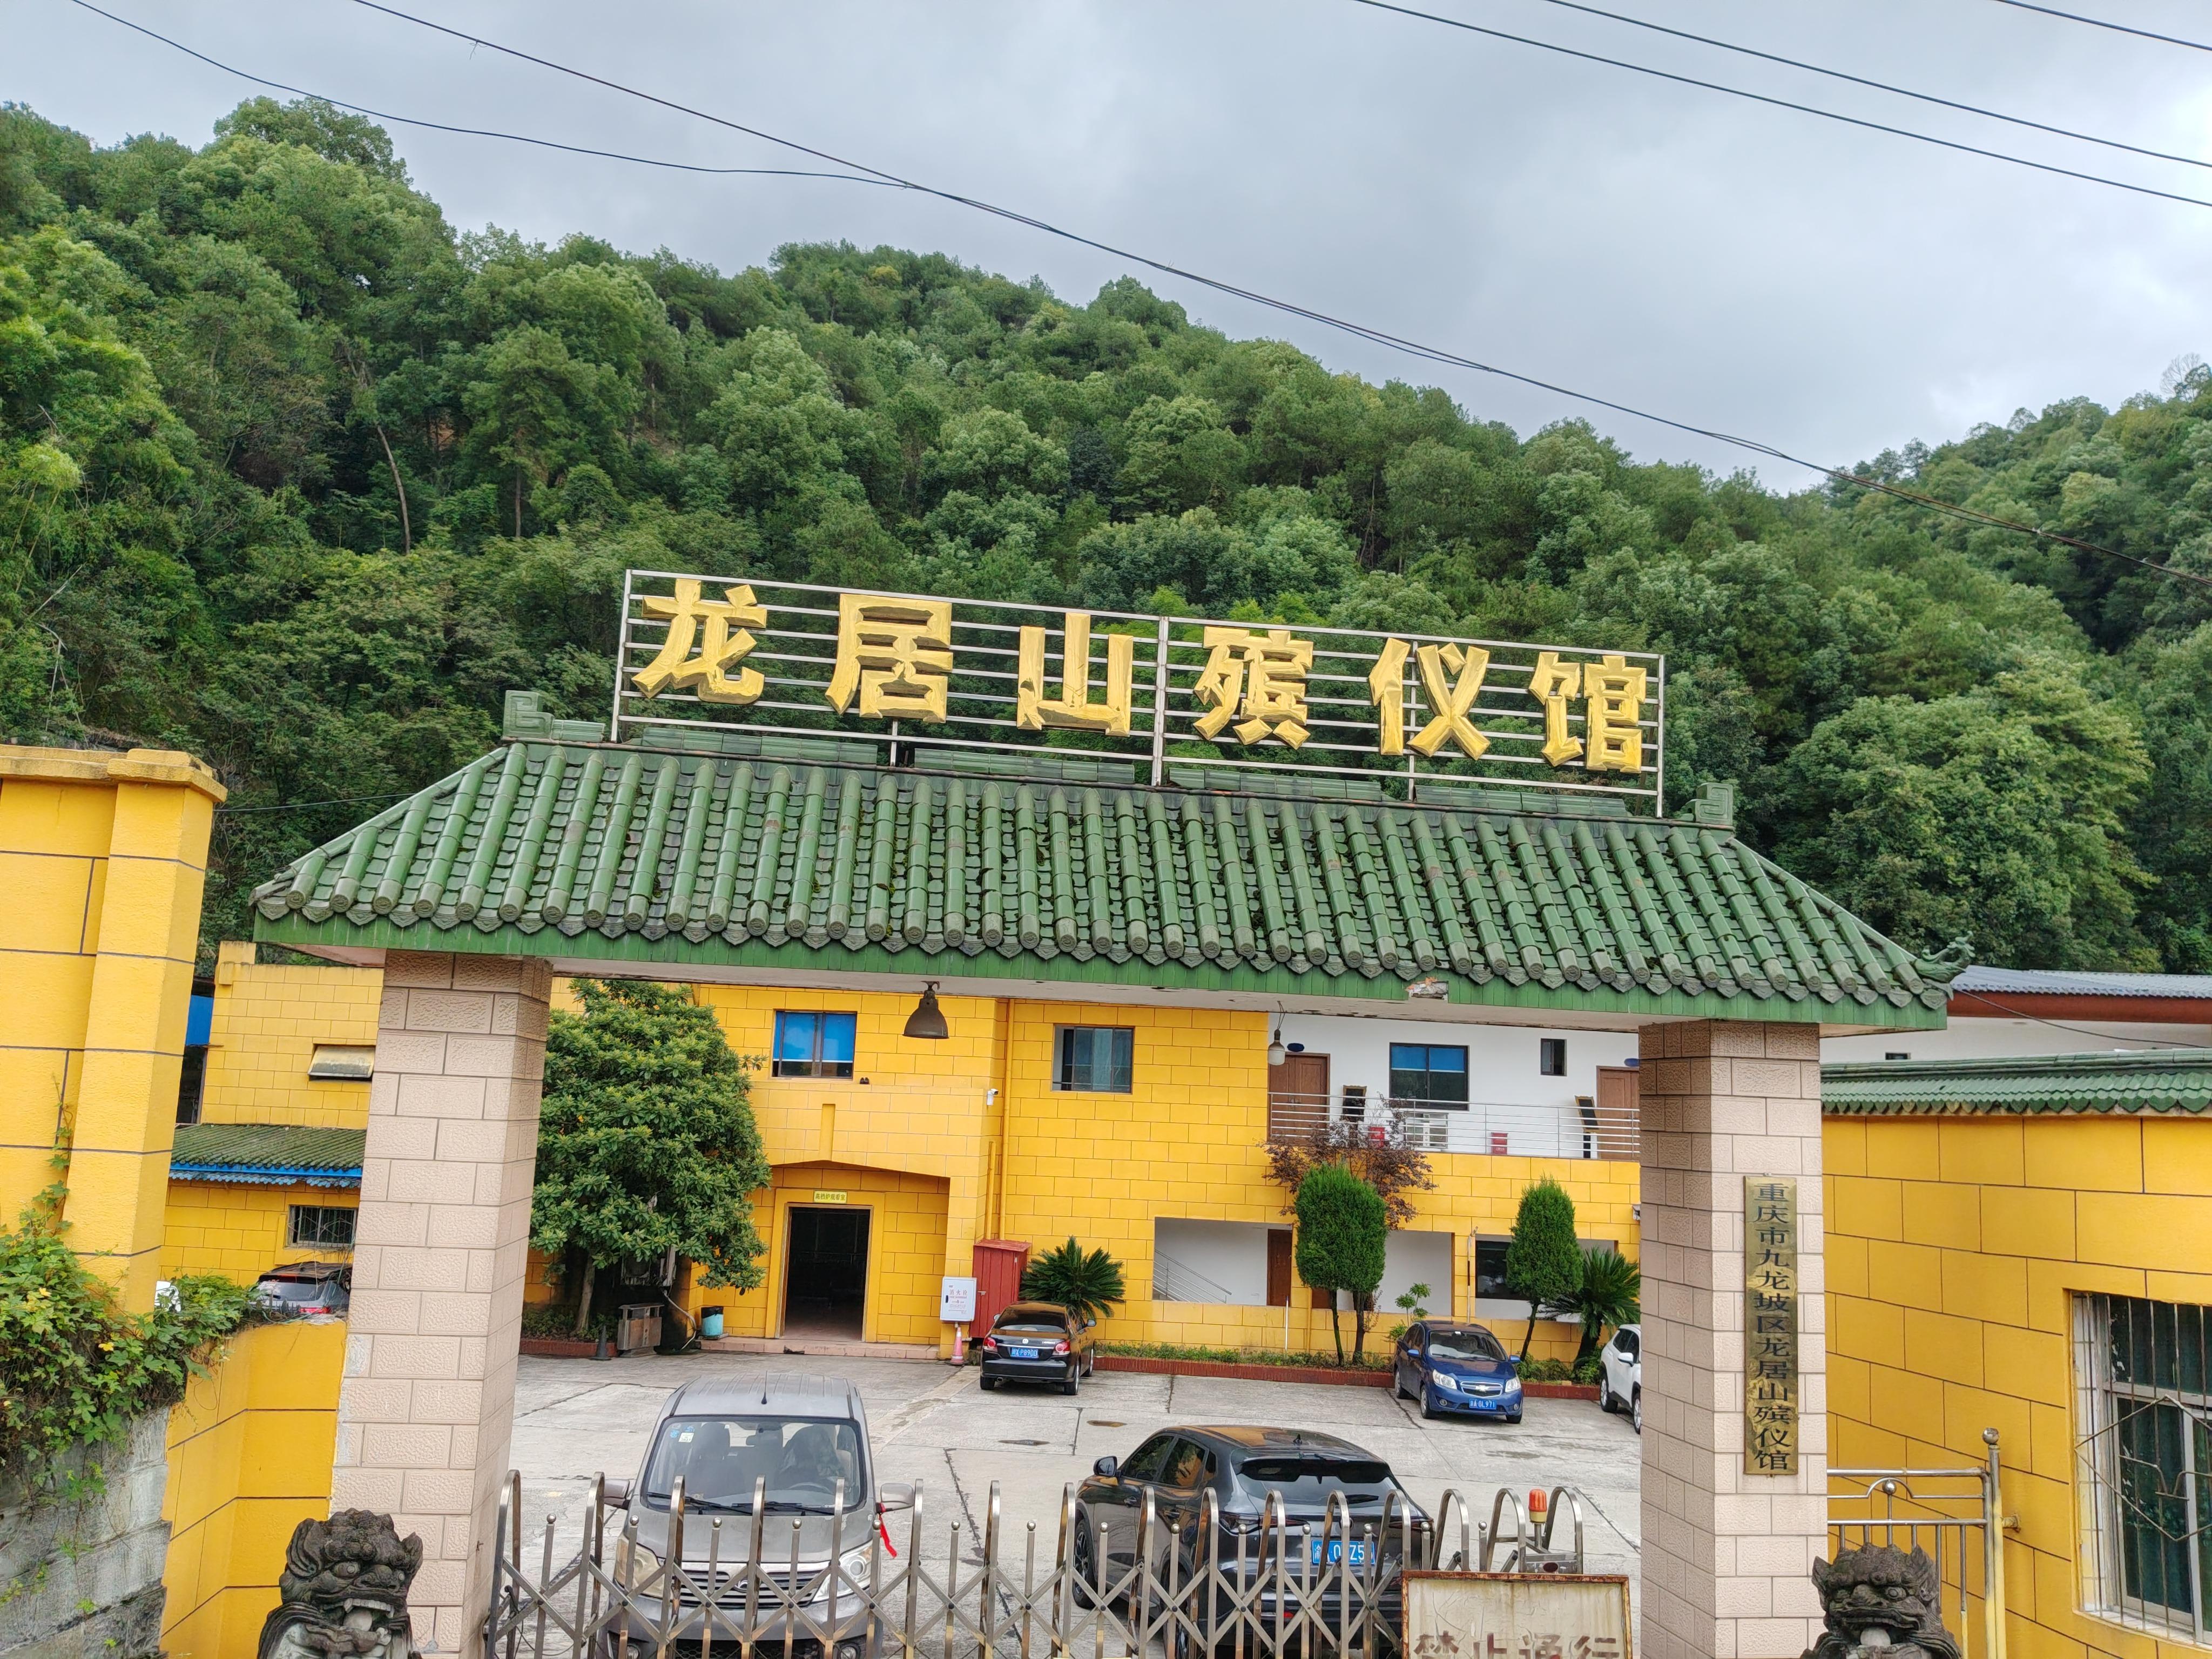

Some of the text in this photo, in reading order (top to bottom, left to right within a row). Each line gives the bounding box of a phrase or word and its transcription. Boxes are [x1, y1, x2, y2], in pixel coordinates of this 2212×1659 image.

[632, 578, 1646, 773] 龙居山殡仪馆
[1753, 1183, 1792, 1471] 重庆市九龙坡区龙居山殡仪馆
